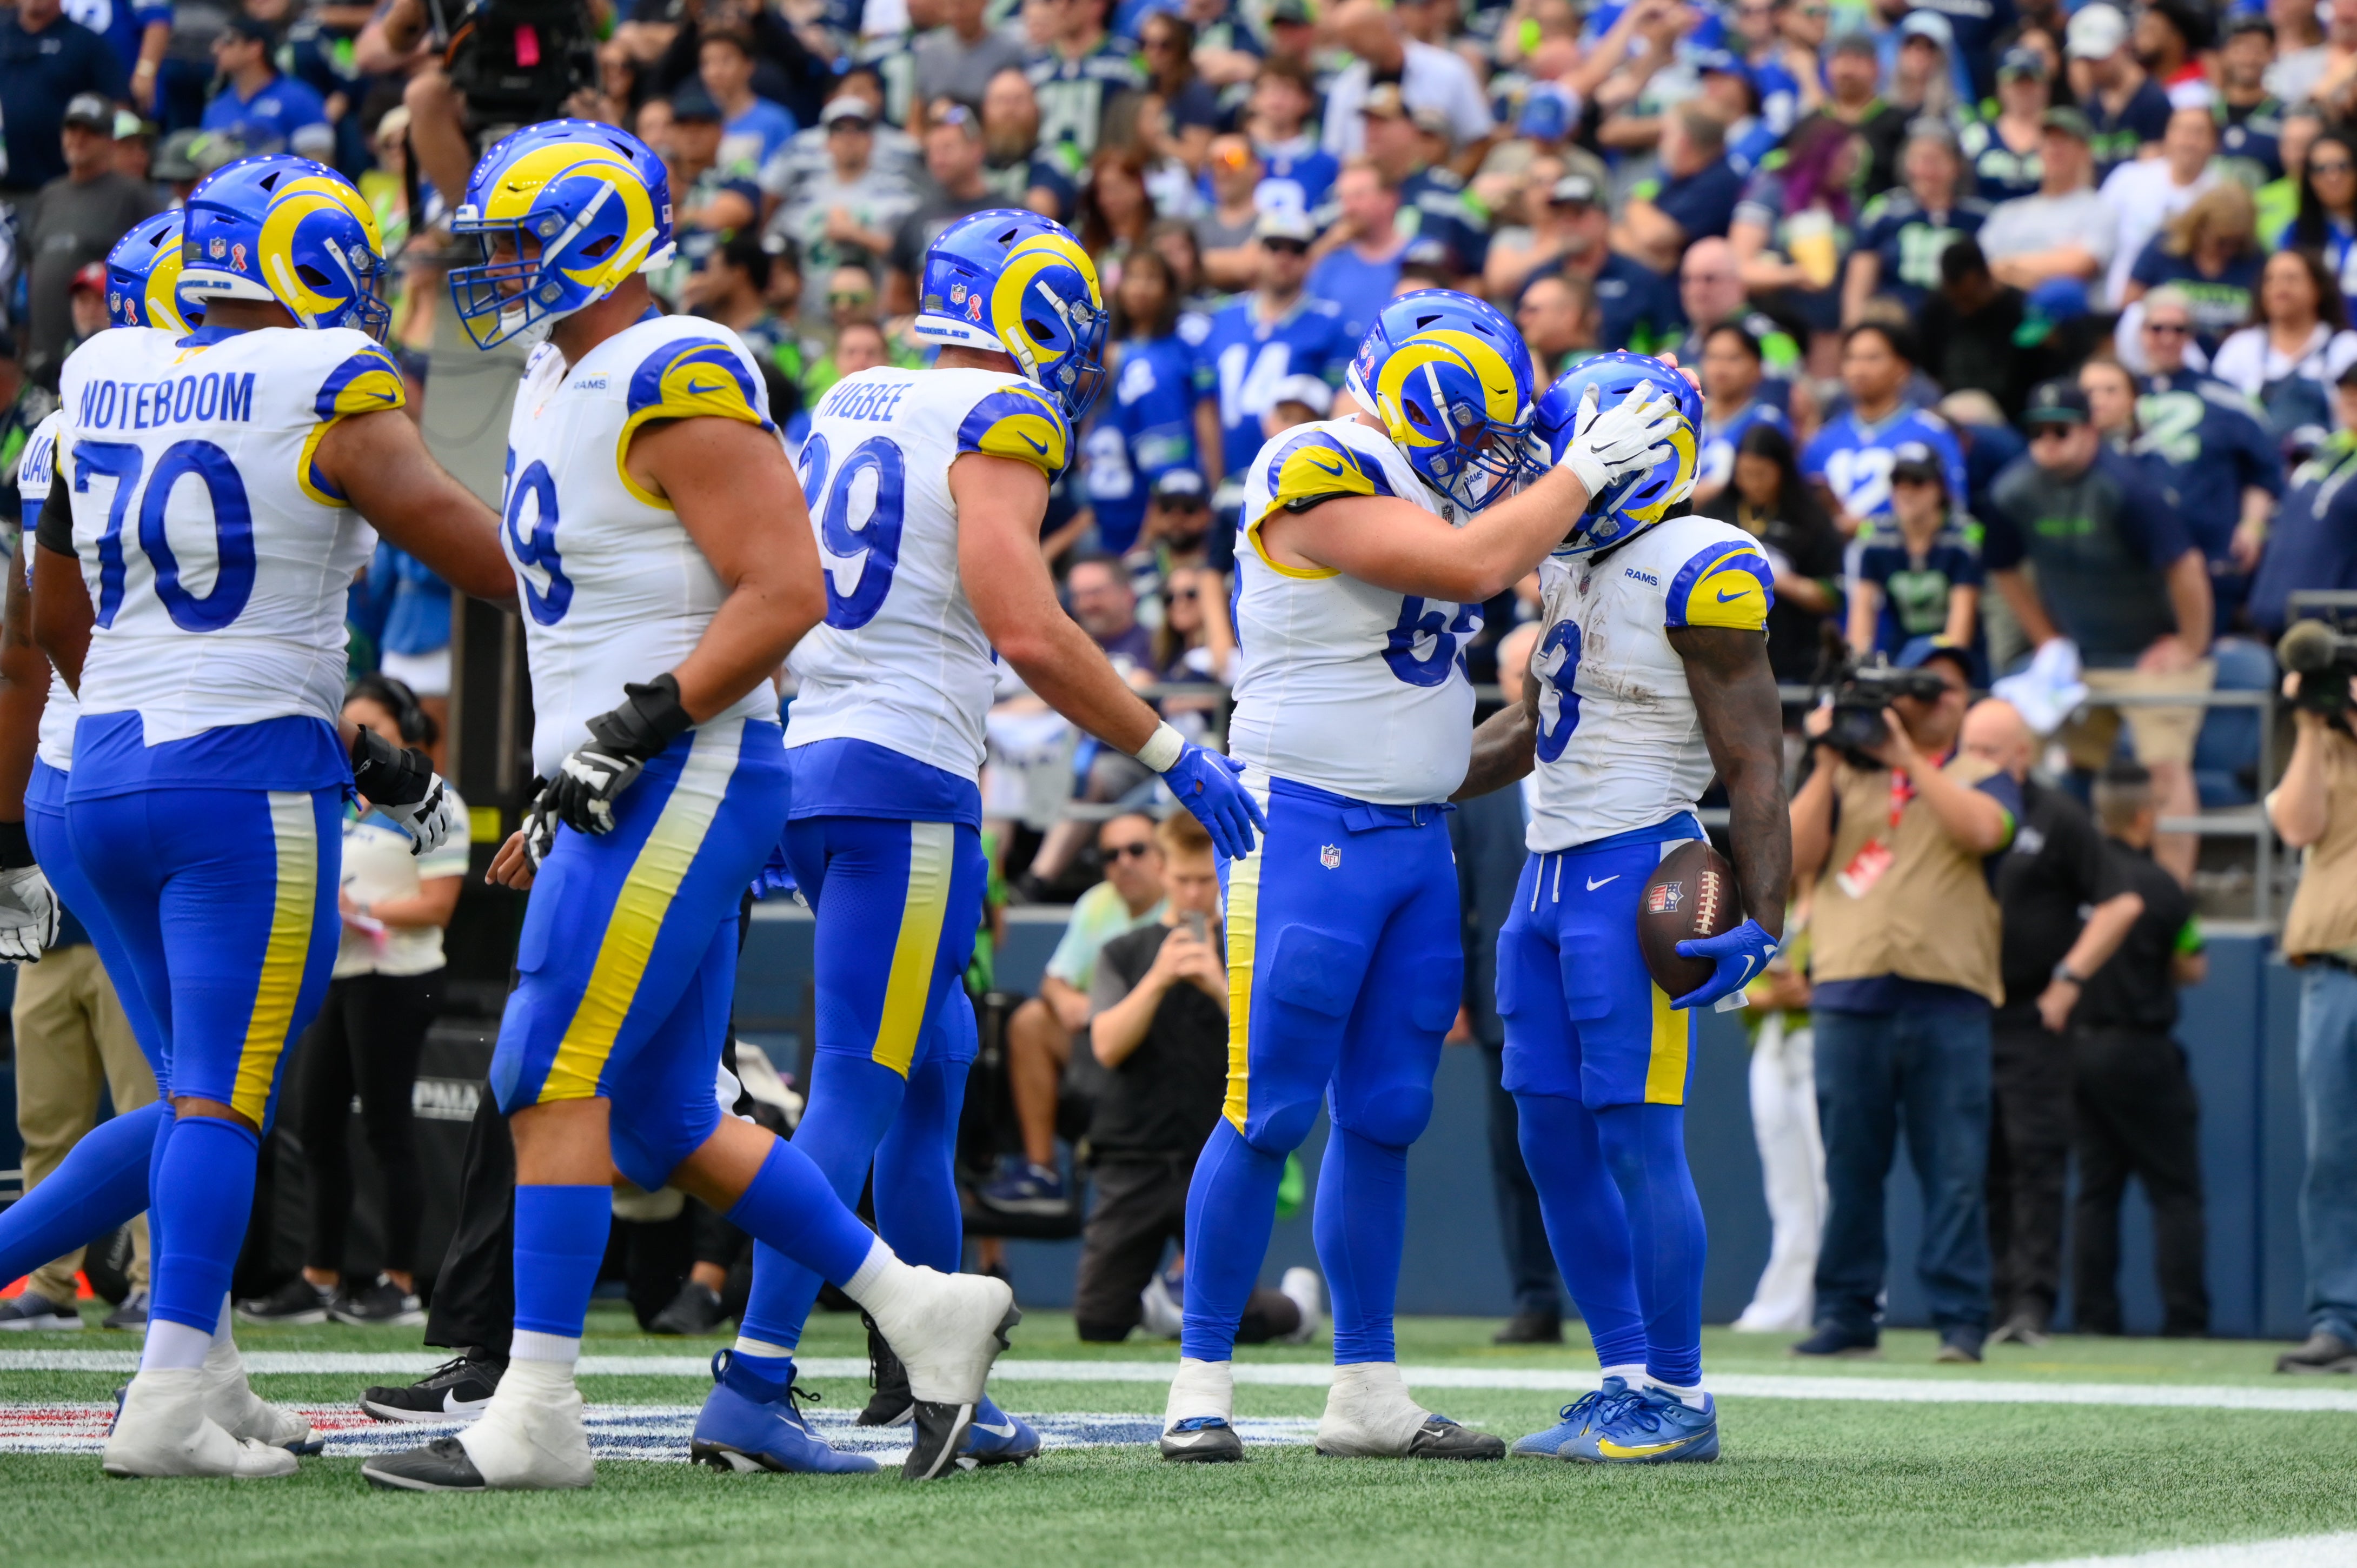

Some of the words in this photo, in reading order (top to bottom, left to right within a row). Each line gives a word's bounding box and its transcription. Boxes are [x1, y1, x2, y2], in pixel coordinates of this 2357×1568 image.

[953, 293, 963, 301] NFL
[76, 372, 256, 430] NOTEBOOM
[819, 383, 914, 422] HIGBEE
[1465, 470, 1483, 485] RAMS
[72, 439, 256, 633] 70
[1624, 568, 1658, 586] RAMS
[1324, 855, 1337, 865] NFL
[1649, 885, 1667, 911] NFL
